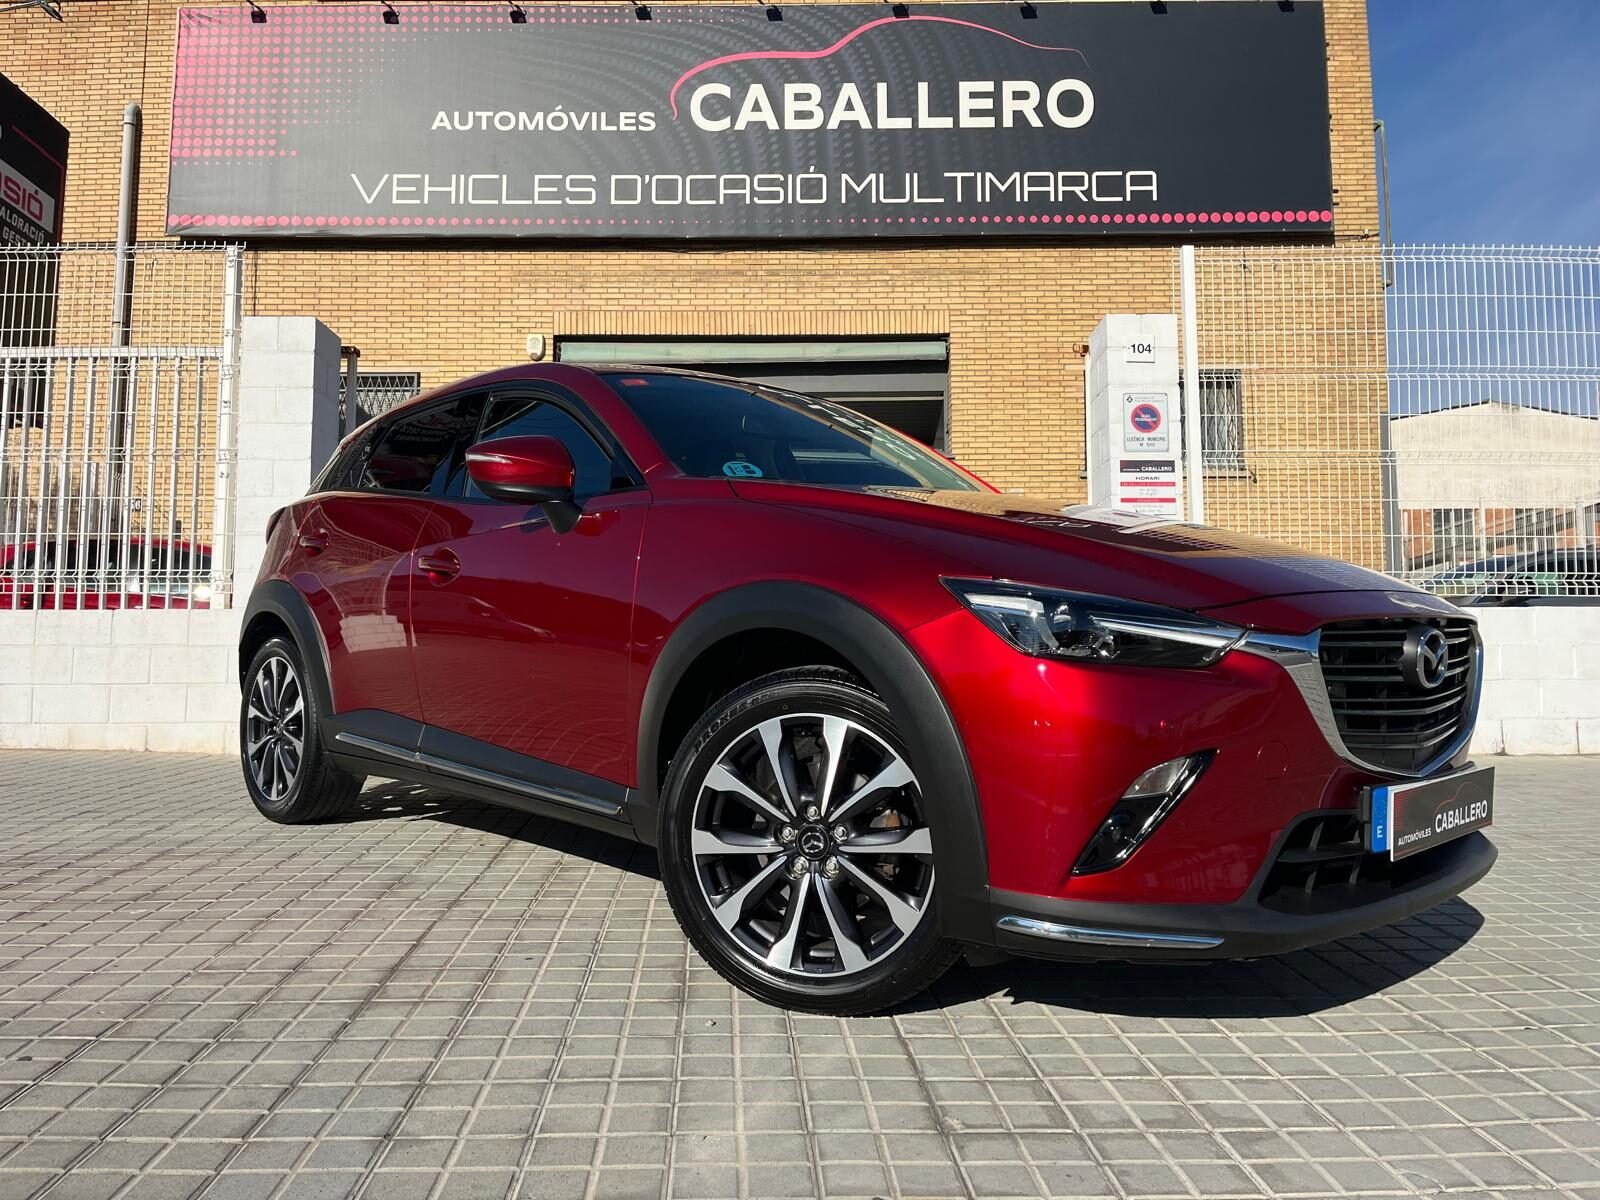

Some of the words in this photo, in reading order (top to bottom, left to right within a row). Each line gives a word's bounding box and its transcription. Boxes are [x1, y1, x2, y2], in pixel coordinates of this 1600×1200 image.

[431, 104, 656, 132] AUTOMÓVILES
[690, 78, 1095, 132] CABALLERO
[350, 172, 598, 206] VEHICLES
[609, 165, 828, 206] D'OCASIÓ
[841, 170, 1159, 205] MULTIMARCA
[0, 205, 45, 244] ALORACIÓ
[1131, 343, 1152, 354] 104
[1376, 825, 1383, 838] E
[1398, 828, 1432, 846] AUTOMÓVILES
[1435, 800, 1488, 833] CABALLERO
